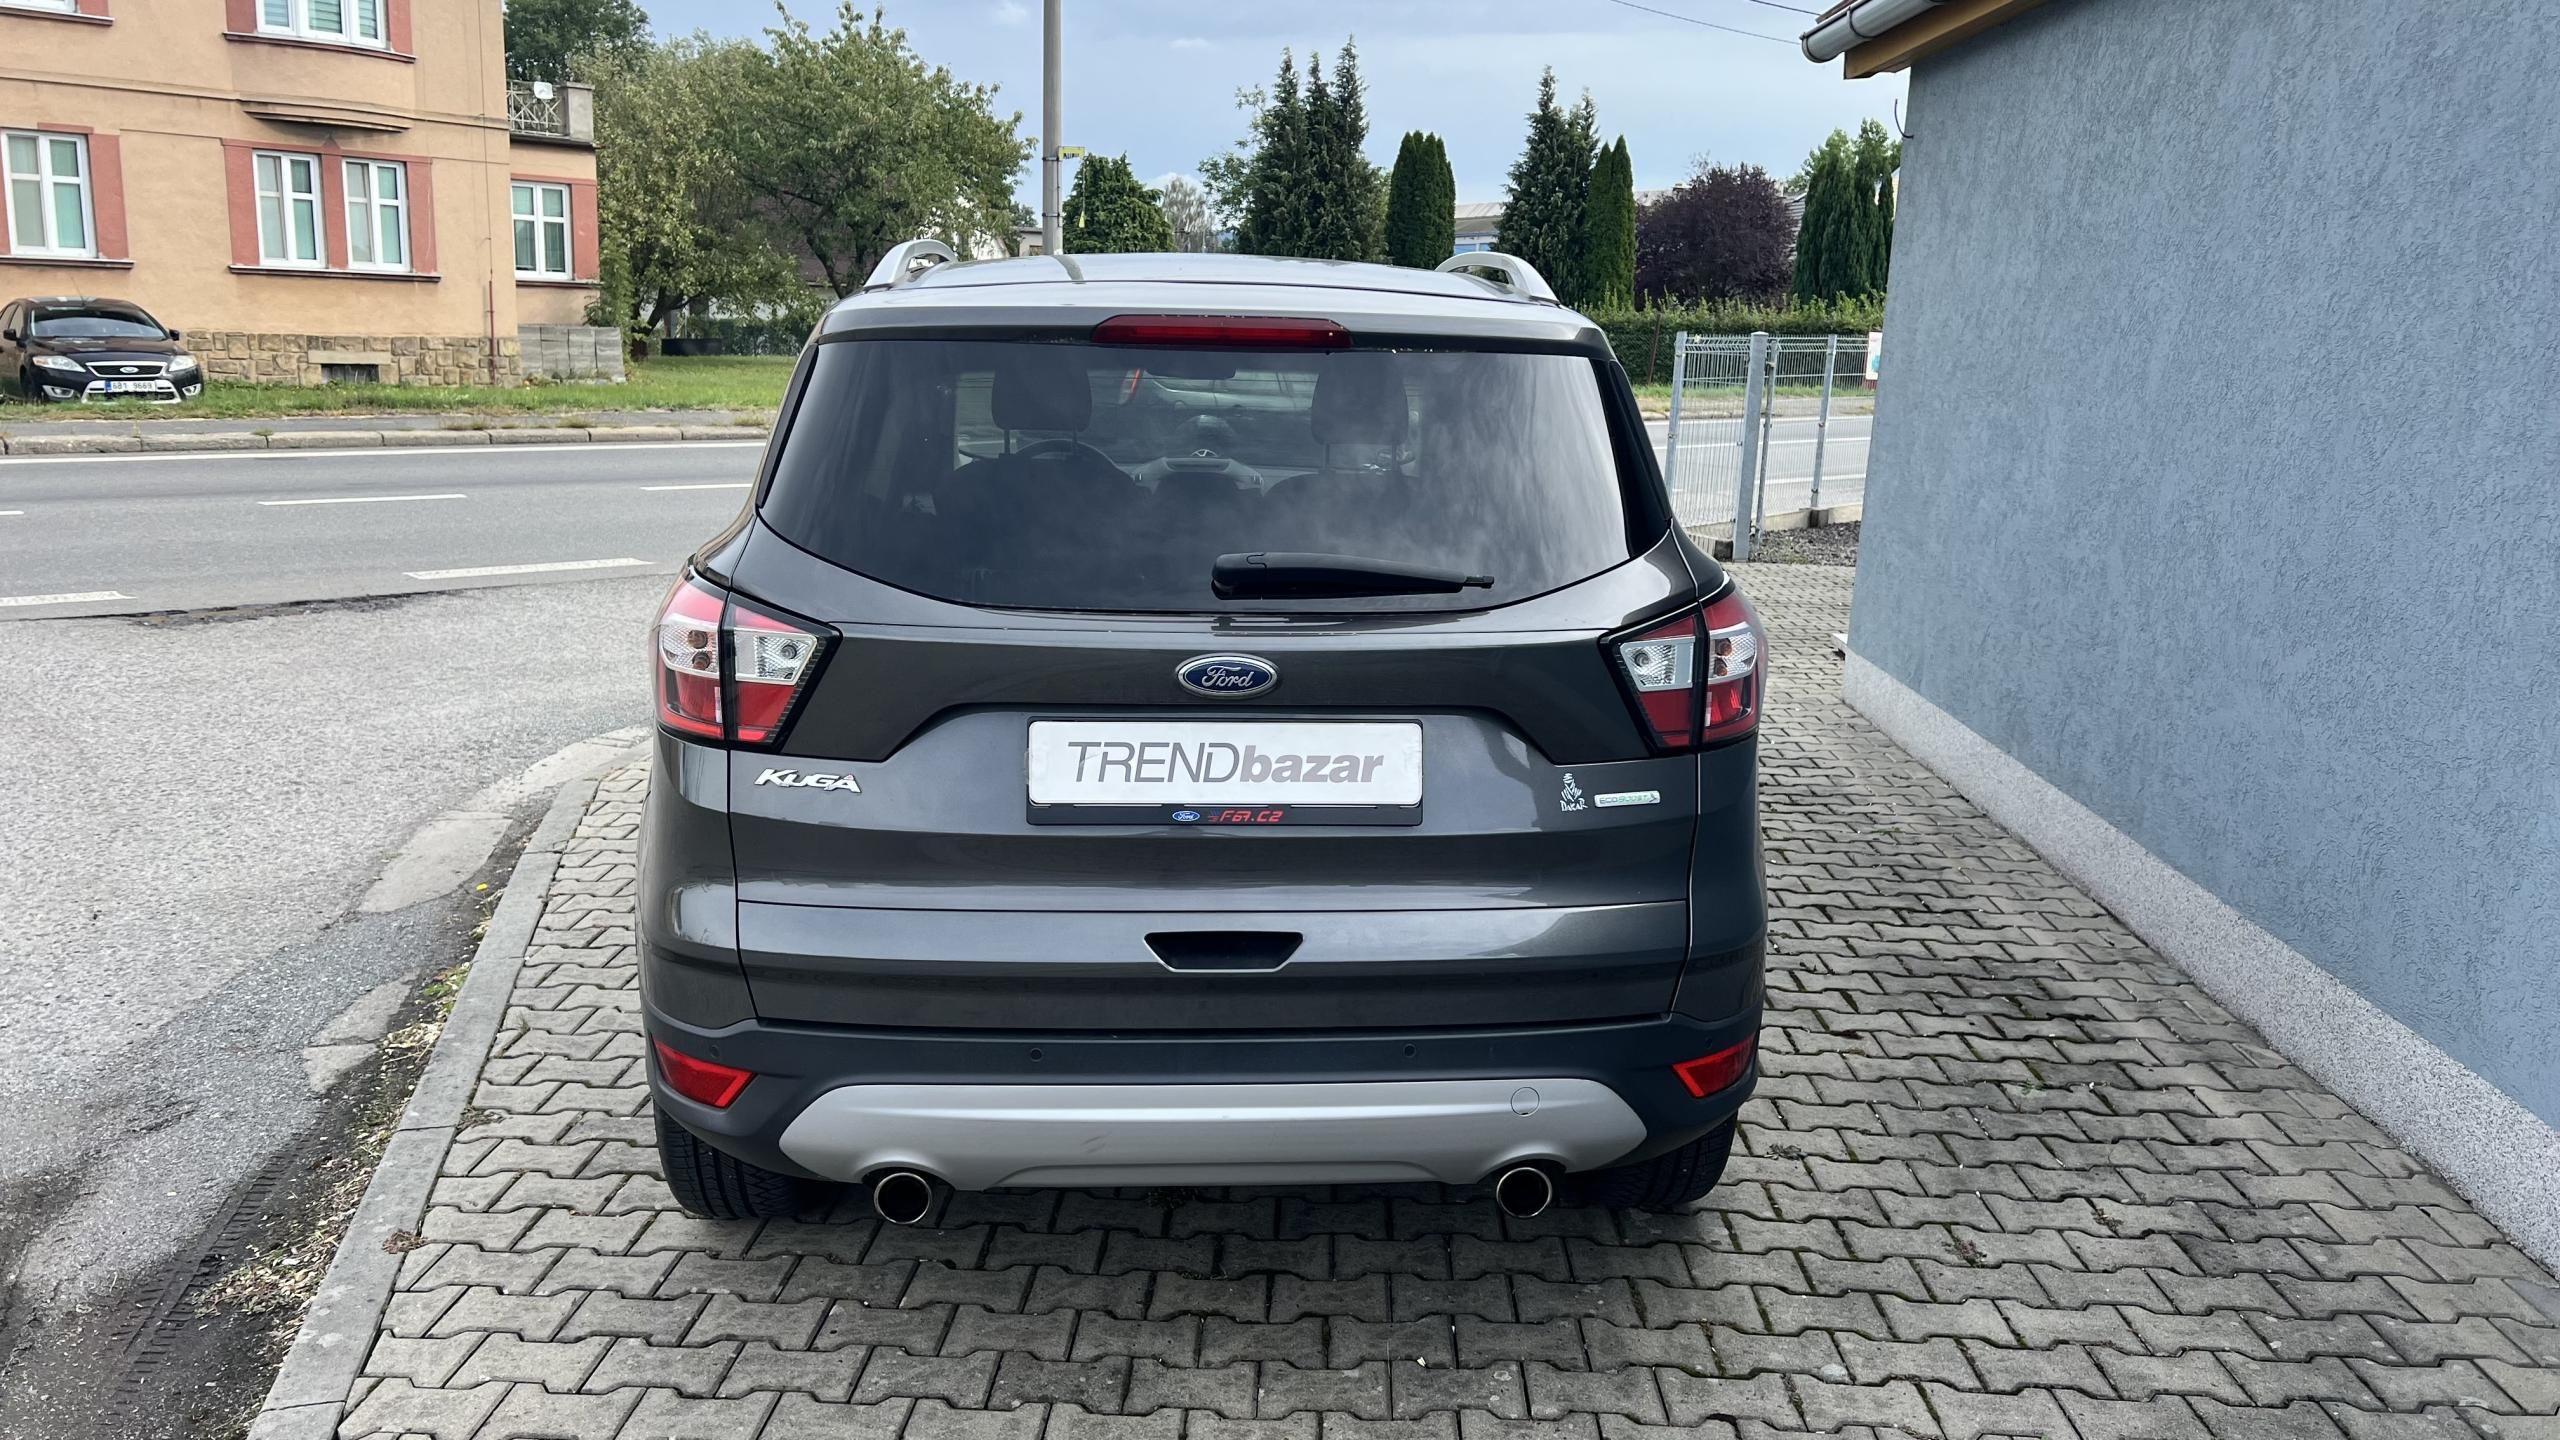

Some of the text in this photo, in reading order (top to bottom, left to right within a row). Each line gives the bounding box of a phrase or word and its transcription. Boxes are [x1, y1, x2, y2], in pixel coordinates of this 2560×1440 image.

[1202, 665, 1255, 687] Ford
[1067, 741, 1384, 783] TRENDbazar
[754, 768, 861, 793] KUGA
